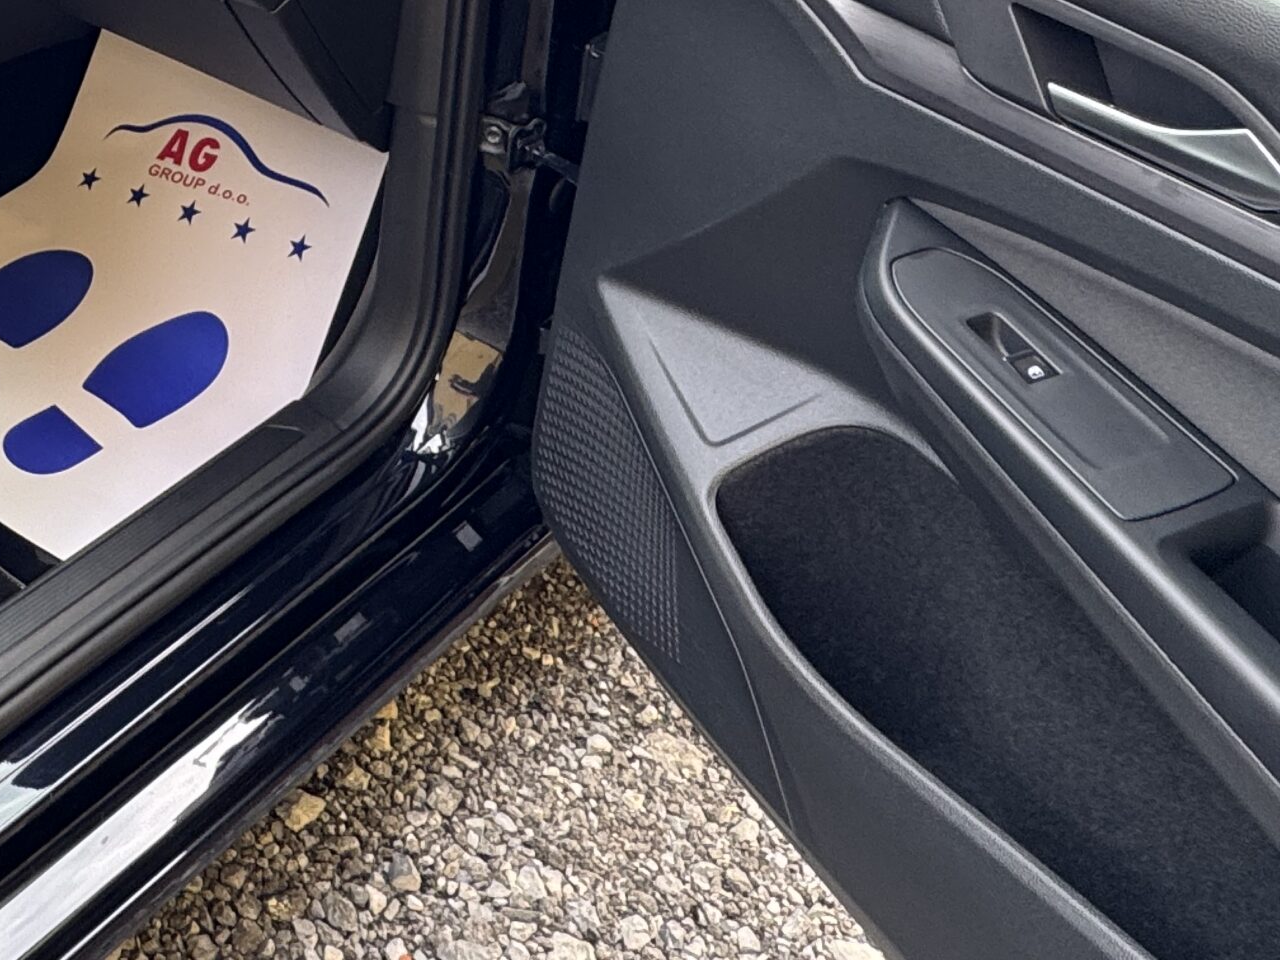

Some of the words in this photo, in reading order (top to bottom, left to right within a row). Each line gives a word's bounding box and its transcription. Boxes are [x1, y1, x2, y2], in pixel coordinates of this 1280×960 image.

[156, 128, 220, 173] AG
[148, 163, 207, 190] GROUP
[207, 183, 250, 206] d.o.o.
